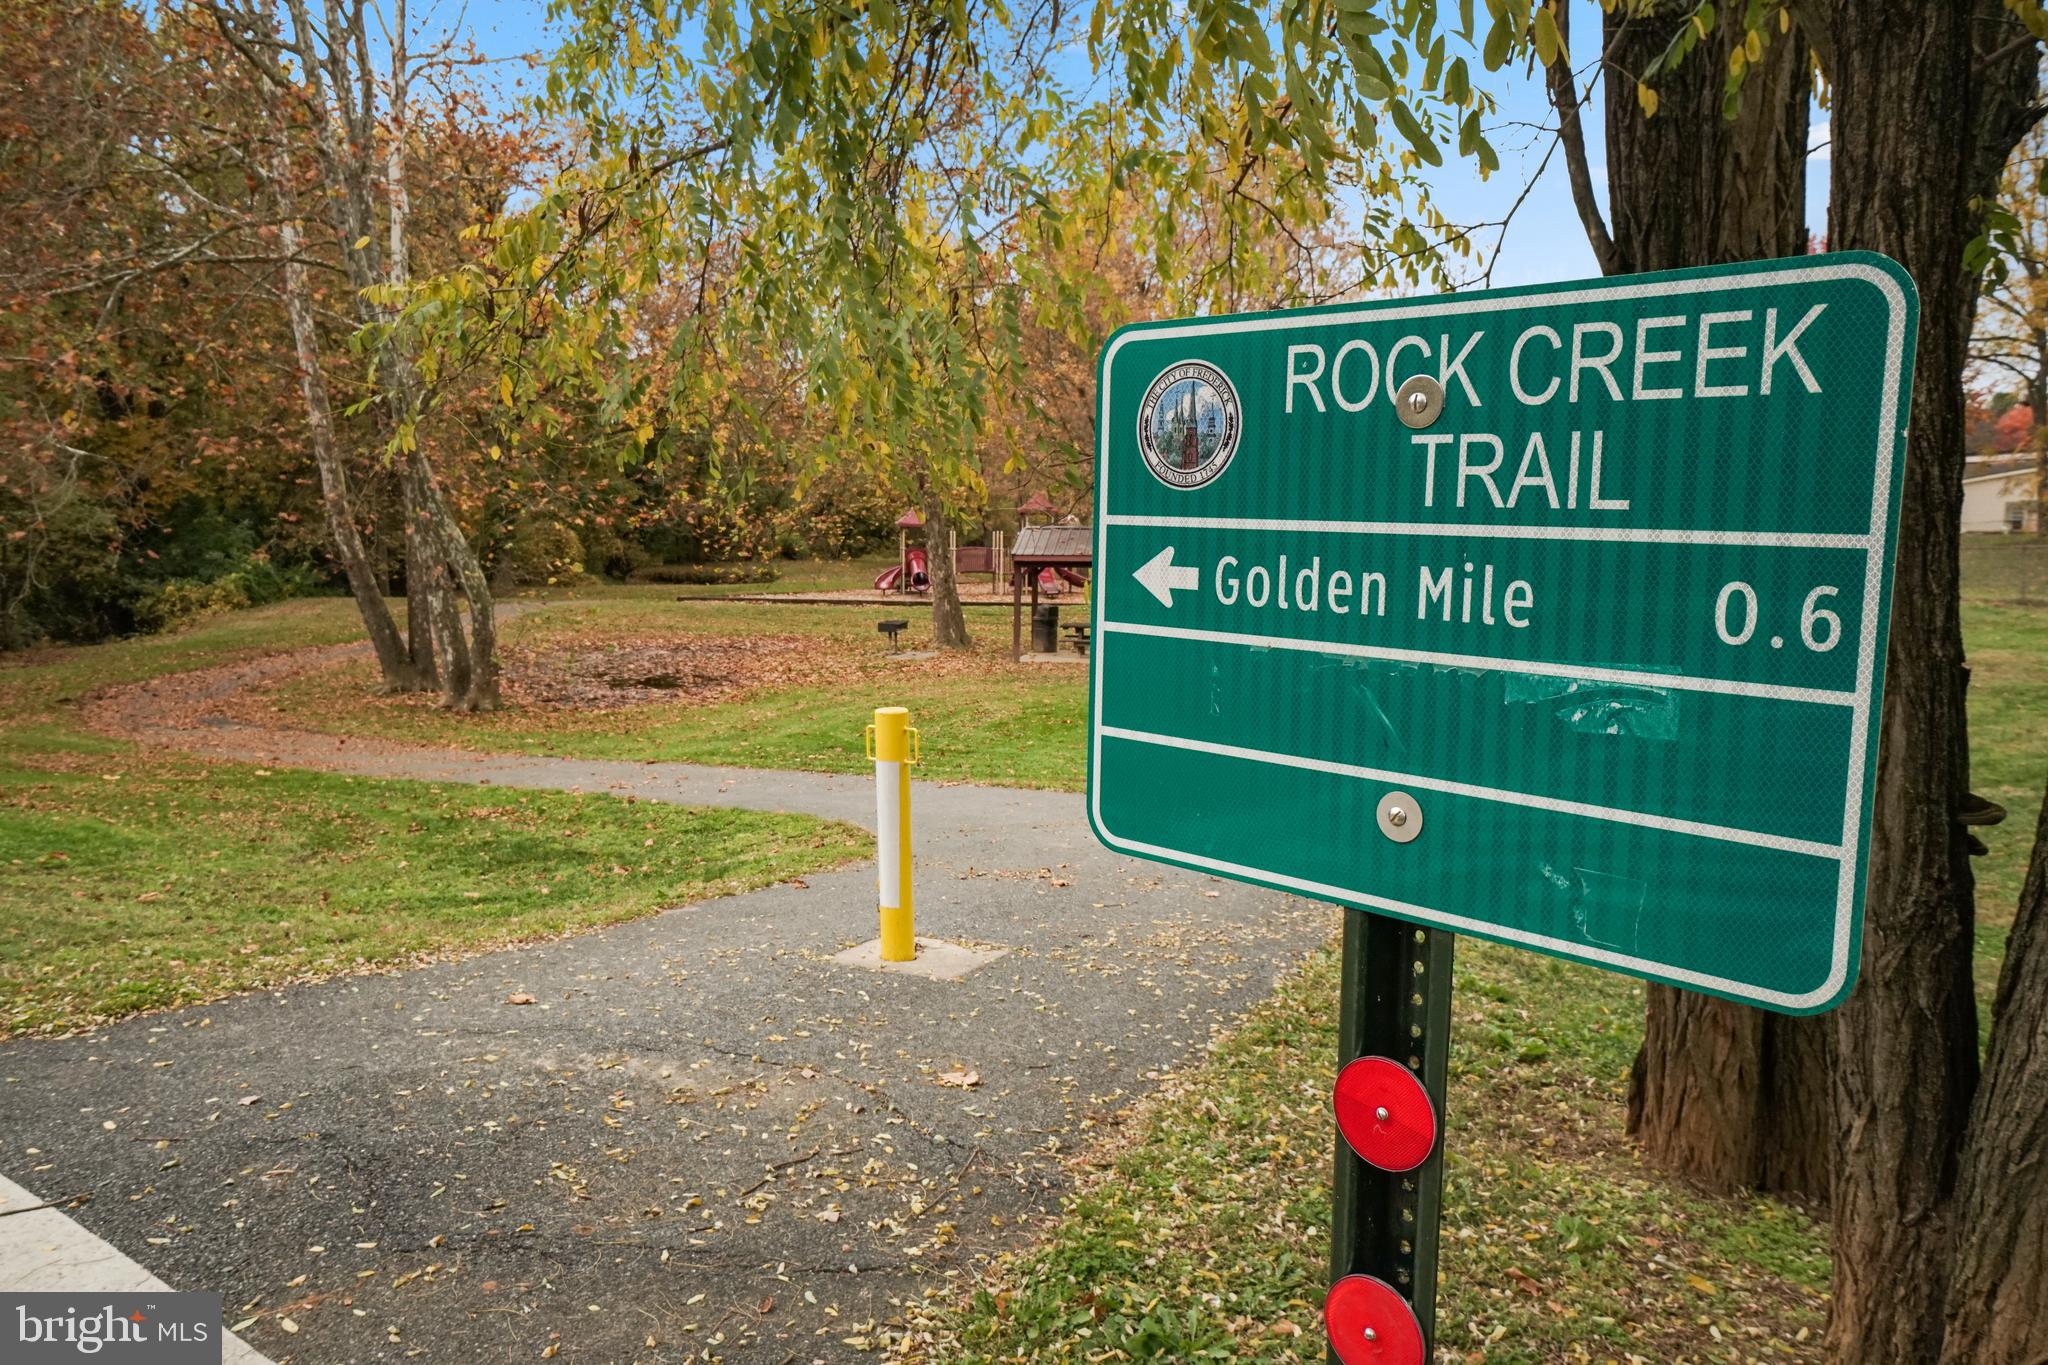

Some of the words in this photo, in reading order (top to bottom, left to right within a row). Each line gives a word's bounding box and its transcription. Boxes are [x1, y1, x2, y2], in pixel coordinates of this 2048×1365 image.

[1146, 389, 1160, 409] THE
[1159, 372, 1178, 391] CITY
[1178, 368, 1191, 378] OF
[1192, 368, 1233, 406] FREDERICK
[1284, 330, 1485, 414] ROCK
[1509, 303, 1829, 405] CREEK
[1154, 460, 1197, 484] FOUNDED
[1199, 461, 1219, 479] 1745
[1411, 430, 1630, 511] TRAIL
[1215, 555, 1386, 617] Golden
[1418, 562, 1535, 629] Mile
[1714, 581, 1842, 653] 0.6
